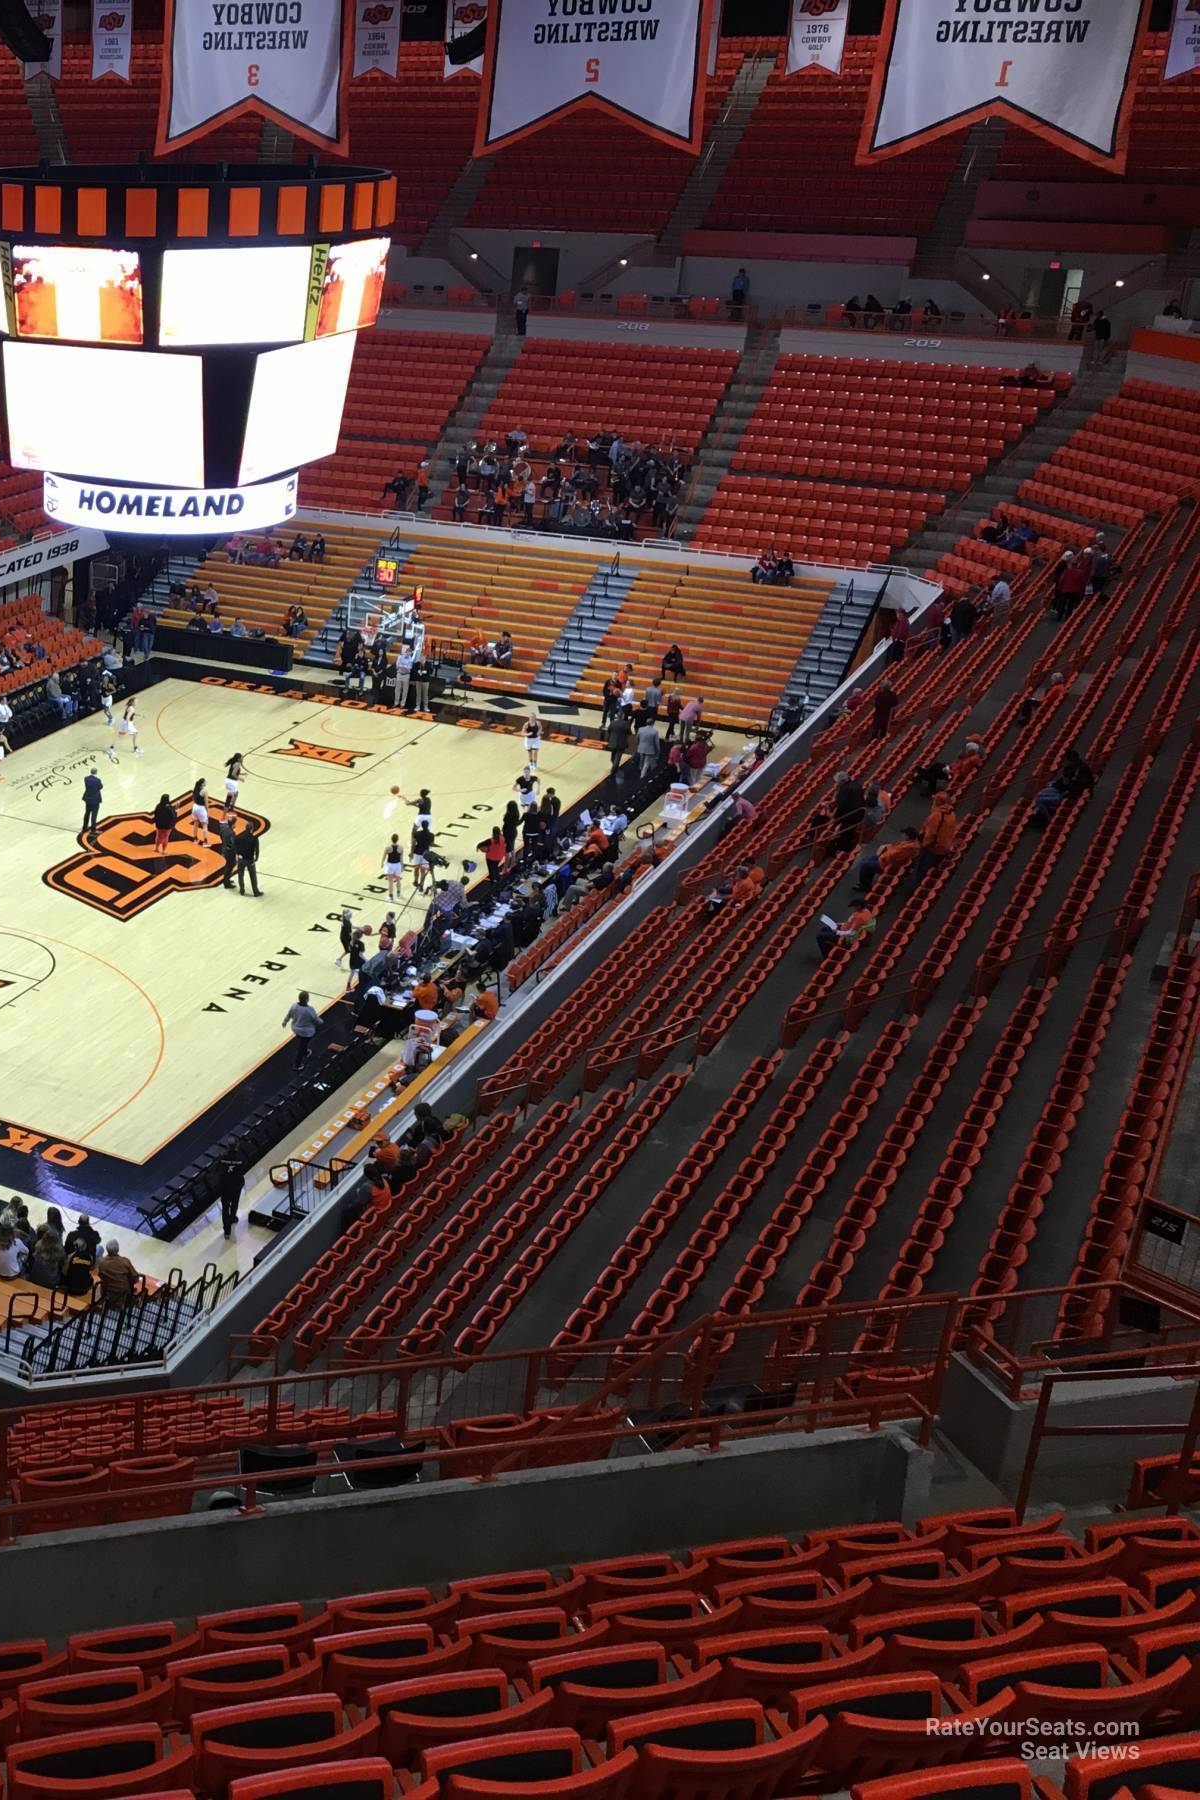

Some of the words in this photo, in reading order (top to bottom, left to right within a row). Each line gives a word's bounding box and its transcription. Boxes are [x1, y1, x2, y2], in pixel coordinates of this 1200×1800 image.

[806, 24, 829, 33] 1976
[0, 246, 13, 302] Hertz
[309, 247, 327, 306] Hertz
[617, 321, 649, 331] 208
[904, 337, 943, 349] 209
[78, 489, 244, 517] HOMELAND
[47, 539, 79, 560] 1938
[200, 675, 437, 722] OKLAHOMA
[456, 718, 609, 749] STTE
[42, 790, 271, 922] OSU
[201, 946, 301, 1014] ARENA
